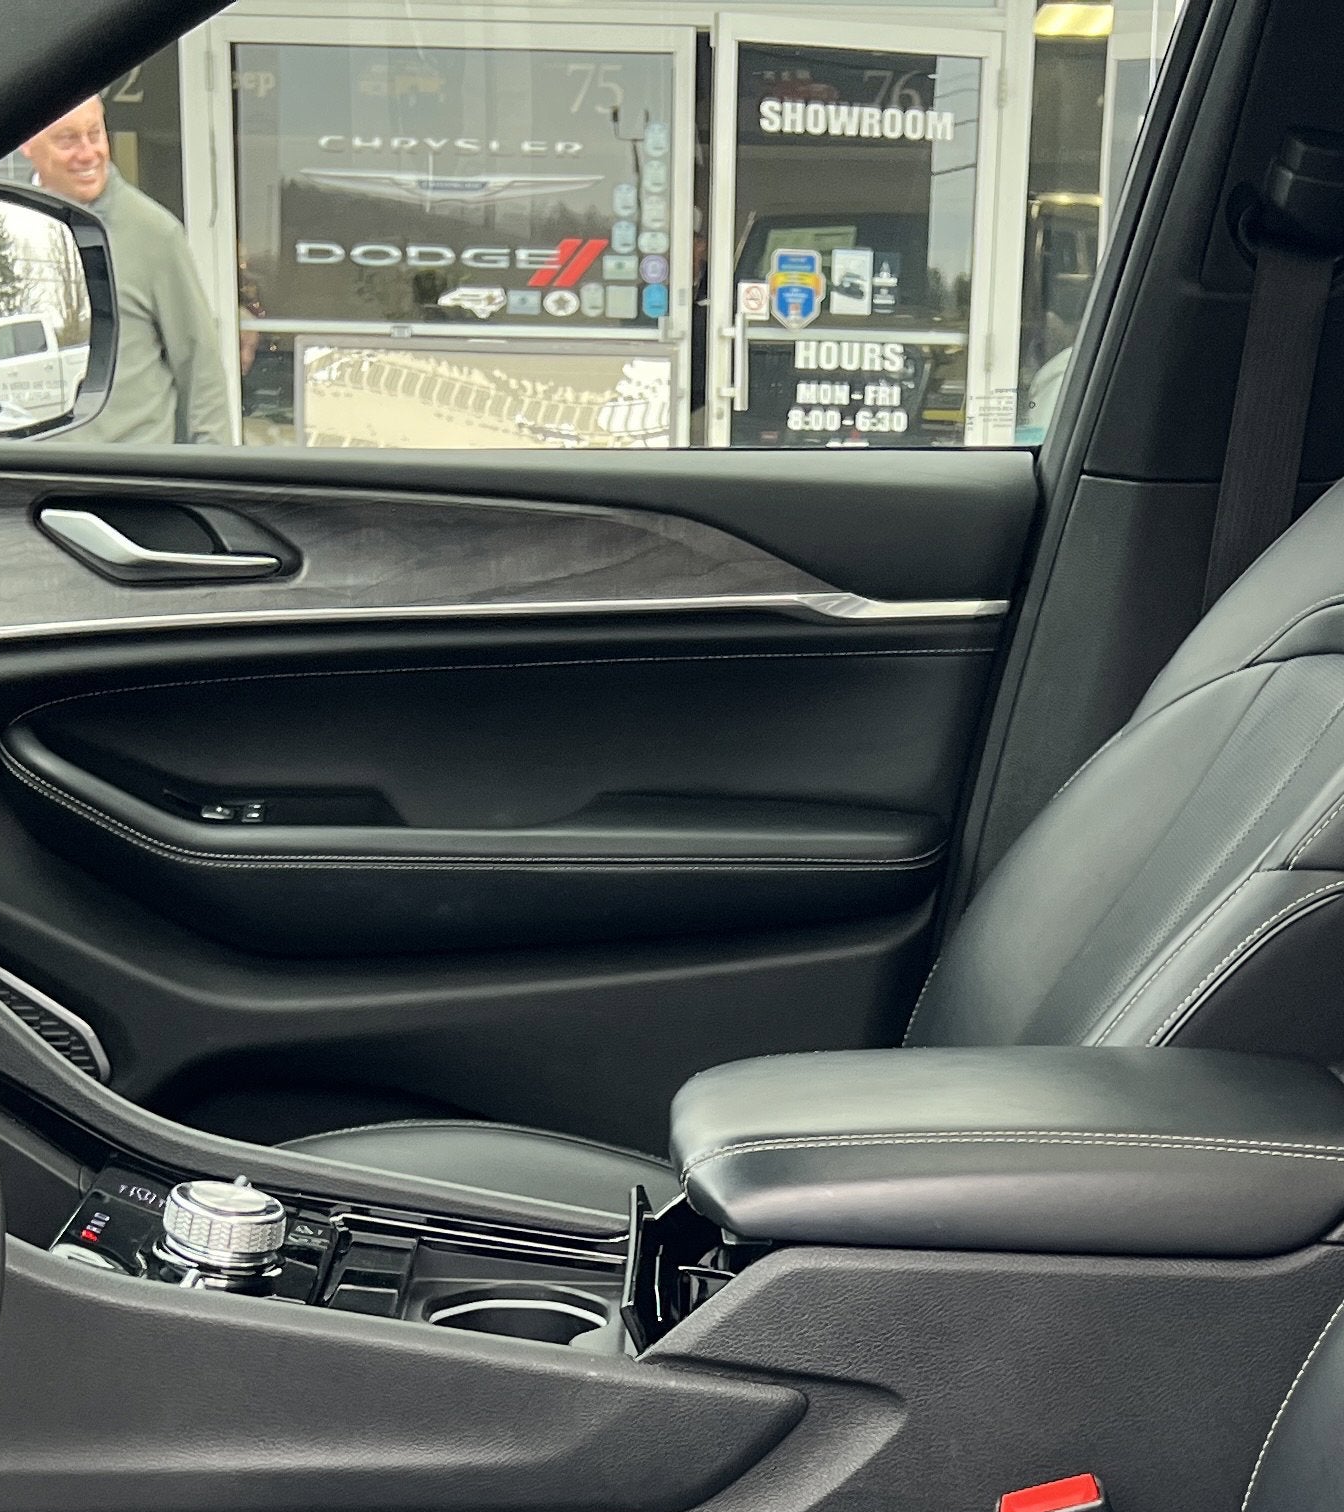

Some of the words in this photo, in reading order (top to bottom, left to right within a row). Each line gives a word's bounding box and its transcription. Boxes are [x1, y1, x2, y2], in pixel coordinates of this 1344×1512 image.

[759, 98, 954, 141] SHOWROOM
[318, 134, 584, 157] CHRYSLER
[294, 239, 563, 270] DODGE
[794, 340, 905, 372] HOURS
